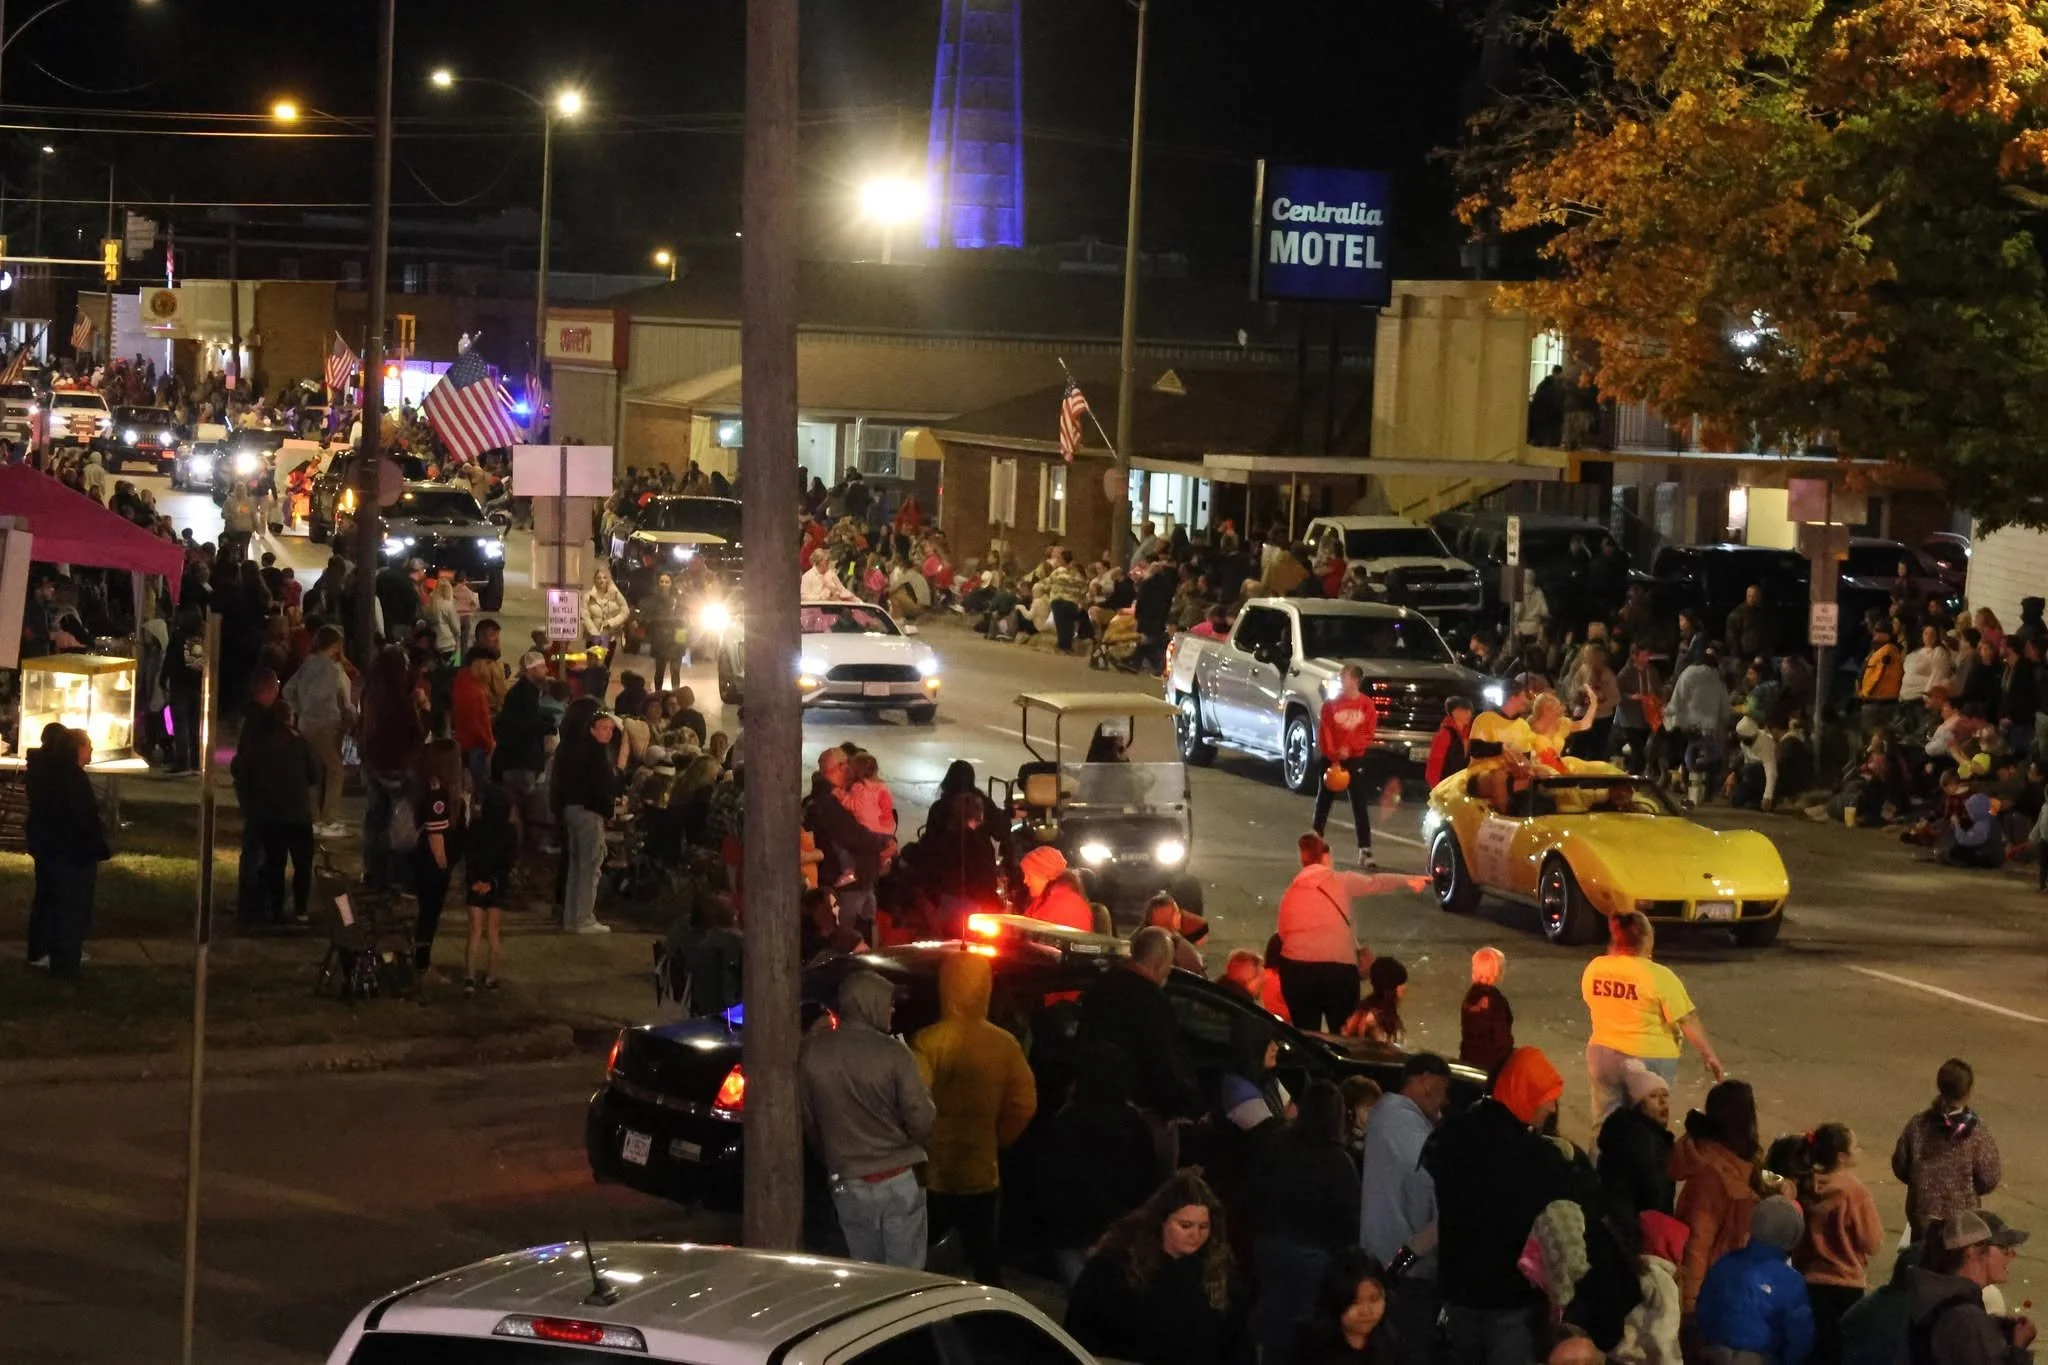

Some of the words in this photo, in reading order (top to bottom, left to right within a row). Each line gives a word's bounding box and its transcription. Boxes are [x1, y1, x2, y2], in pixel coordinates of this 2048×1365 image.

[1272, 197, 1384, 226] Centralia
[1270, 230, 1383, 269] MOTEL
[559, 596, 568, 604] NO
[1593, 979, 1638, 1000] ESDA
